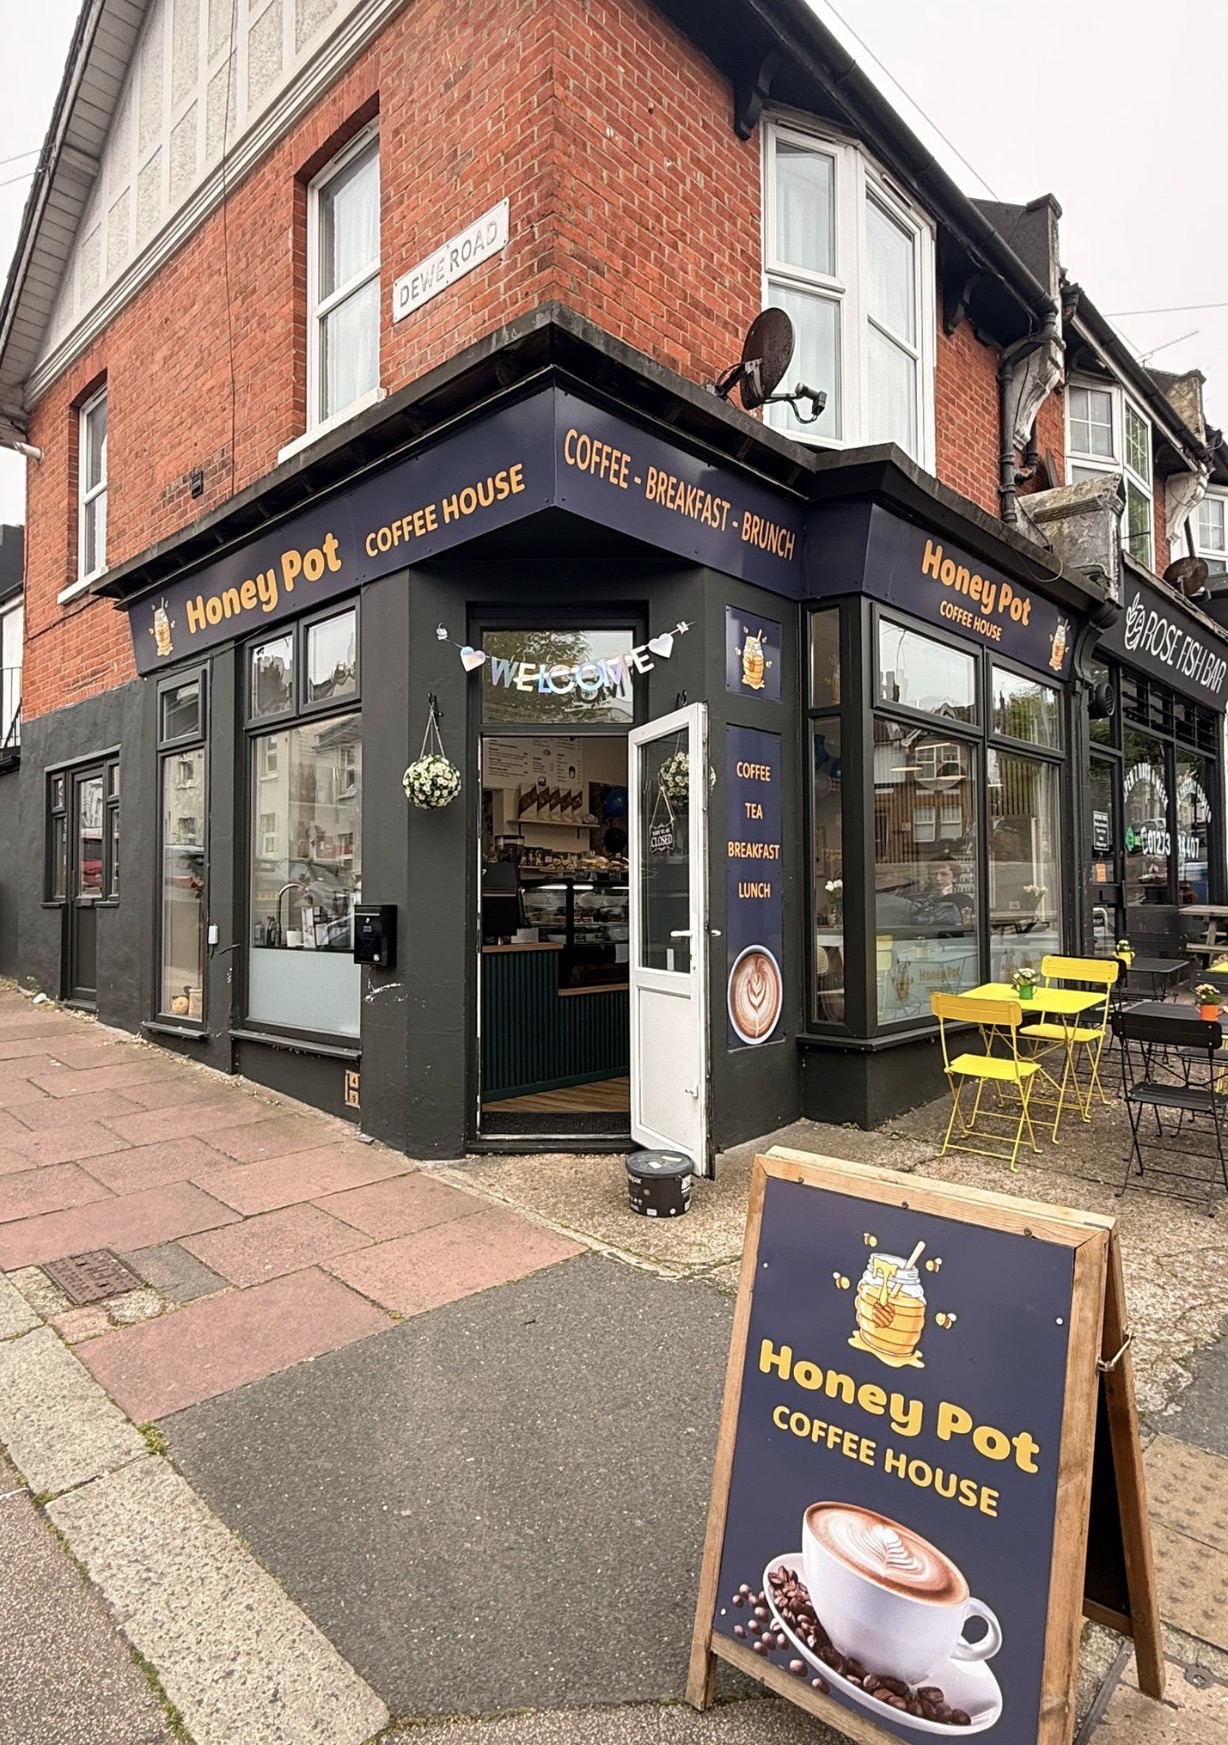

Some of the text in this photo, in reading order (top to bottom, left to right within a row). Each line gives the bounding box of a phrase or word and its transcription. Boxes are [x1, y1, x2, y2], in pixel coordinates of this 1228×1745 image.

[400, 221, 497, 307] DEWE ROAD
[563, 428, 631, 489] COFFEE
[645, 466, 731, 531] BREAKFAST
[741, 510, 796, 561] BRUNCH
[185, 462, 526, 634] Honey Pot COFFEE HOUSE
[922, 539, 1031, 626] Honey Pot
[940, 600, 1002, 641] COFFEE HOUSE
[1140, 610, 1227, 694] ROSE FISH BAR
[491, 645, 655, 694] WELCOME
[736, 761, 771, 782] COFFEE
[745, 802, 763, 819] TEA
[1147, 829, 1171, 856] 01273
[727, 841, 780, 860] BREAKFAST
[738, 882, 771, 898] LUNCH
[758, 1338, 1040, 1474] Honey Pot
[772, 1405, 1000, 1518] COFFEE HOUSE
